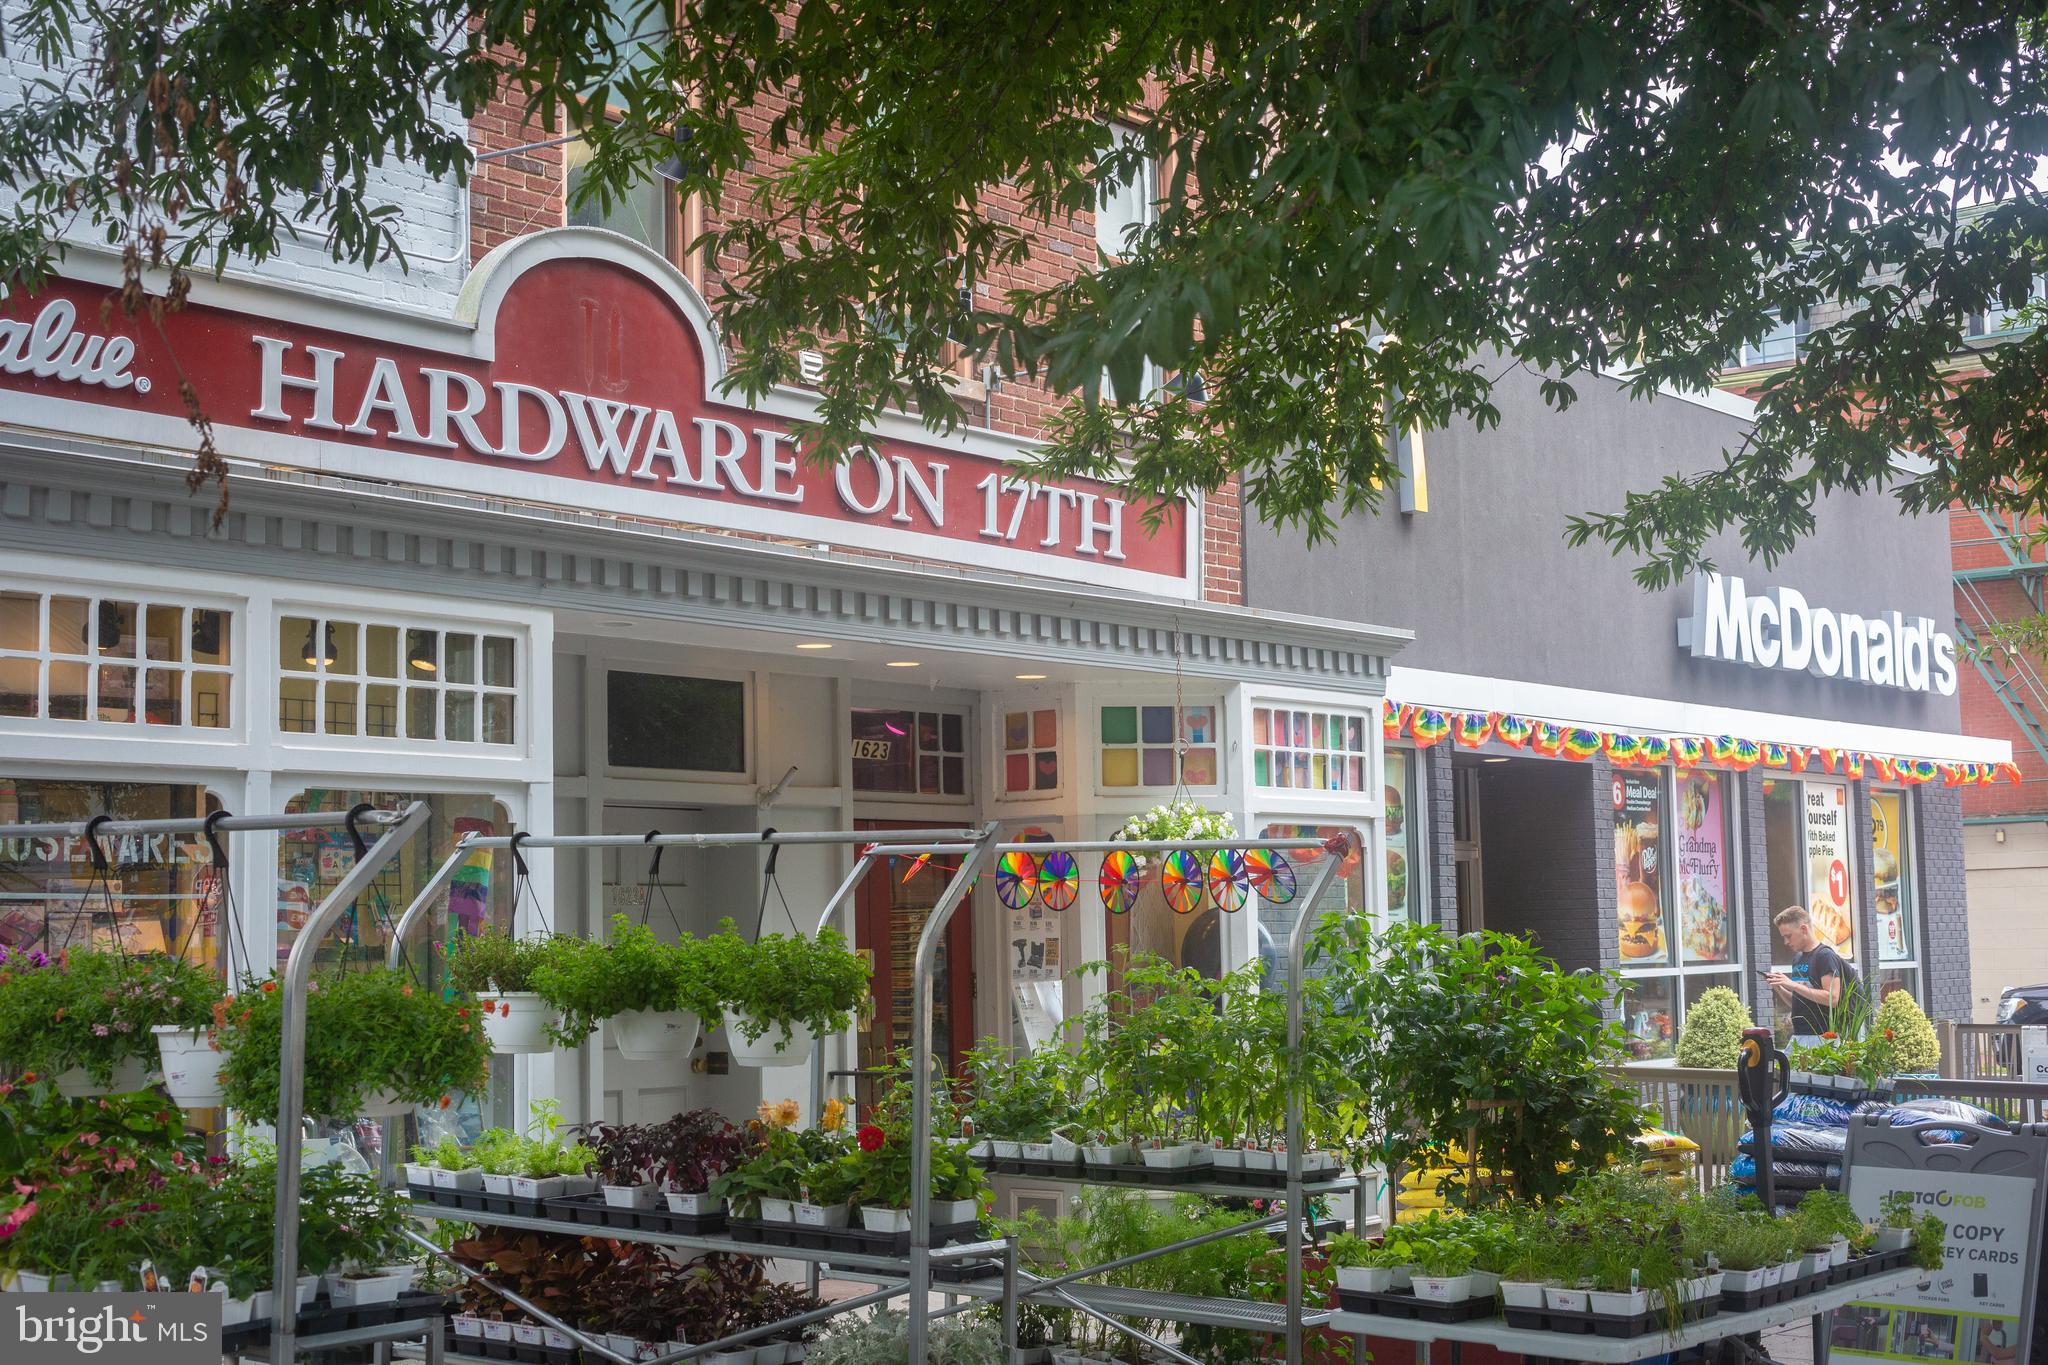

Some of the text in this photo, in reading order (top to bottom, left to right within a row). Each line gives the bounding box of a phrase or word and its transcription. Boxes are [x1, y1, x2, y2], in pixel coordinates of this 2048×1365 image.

[250, 335, 1127, 560] HARDWARE ON 17TH
[1696, 571, 1957, 697] McDonald's
[852, 740, 889, 759] 1623
[1626, 786, 1642, 798] Meal
[1642, 787, 1657, 799] Deal
[1806, 791, 1824, 807] reat
[1807, 809, 1837, 826] ourself
[1818, 830, 1836, 842] Baked
[1678, 834, 1717, 858] Grandma
[1822, 845, 1834, 857] Pies
[1678, 857, 1720, 879] McFlurry
[1953, 1224, 2005, 1242] COPY
[1968, 1249, 2019, 1264] CARDS
